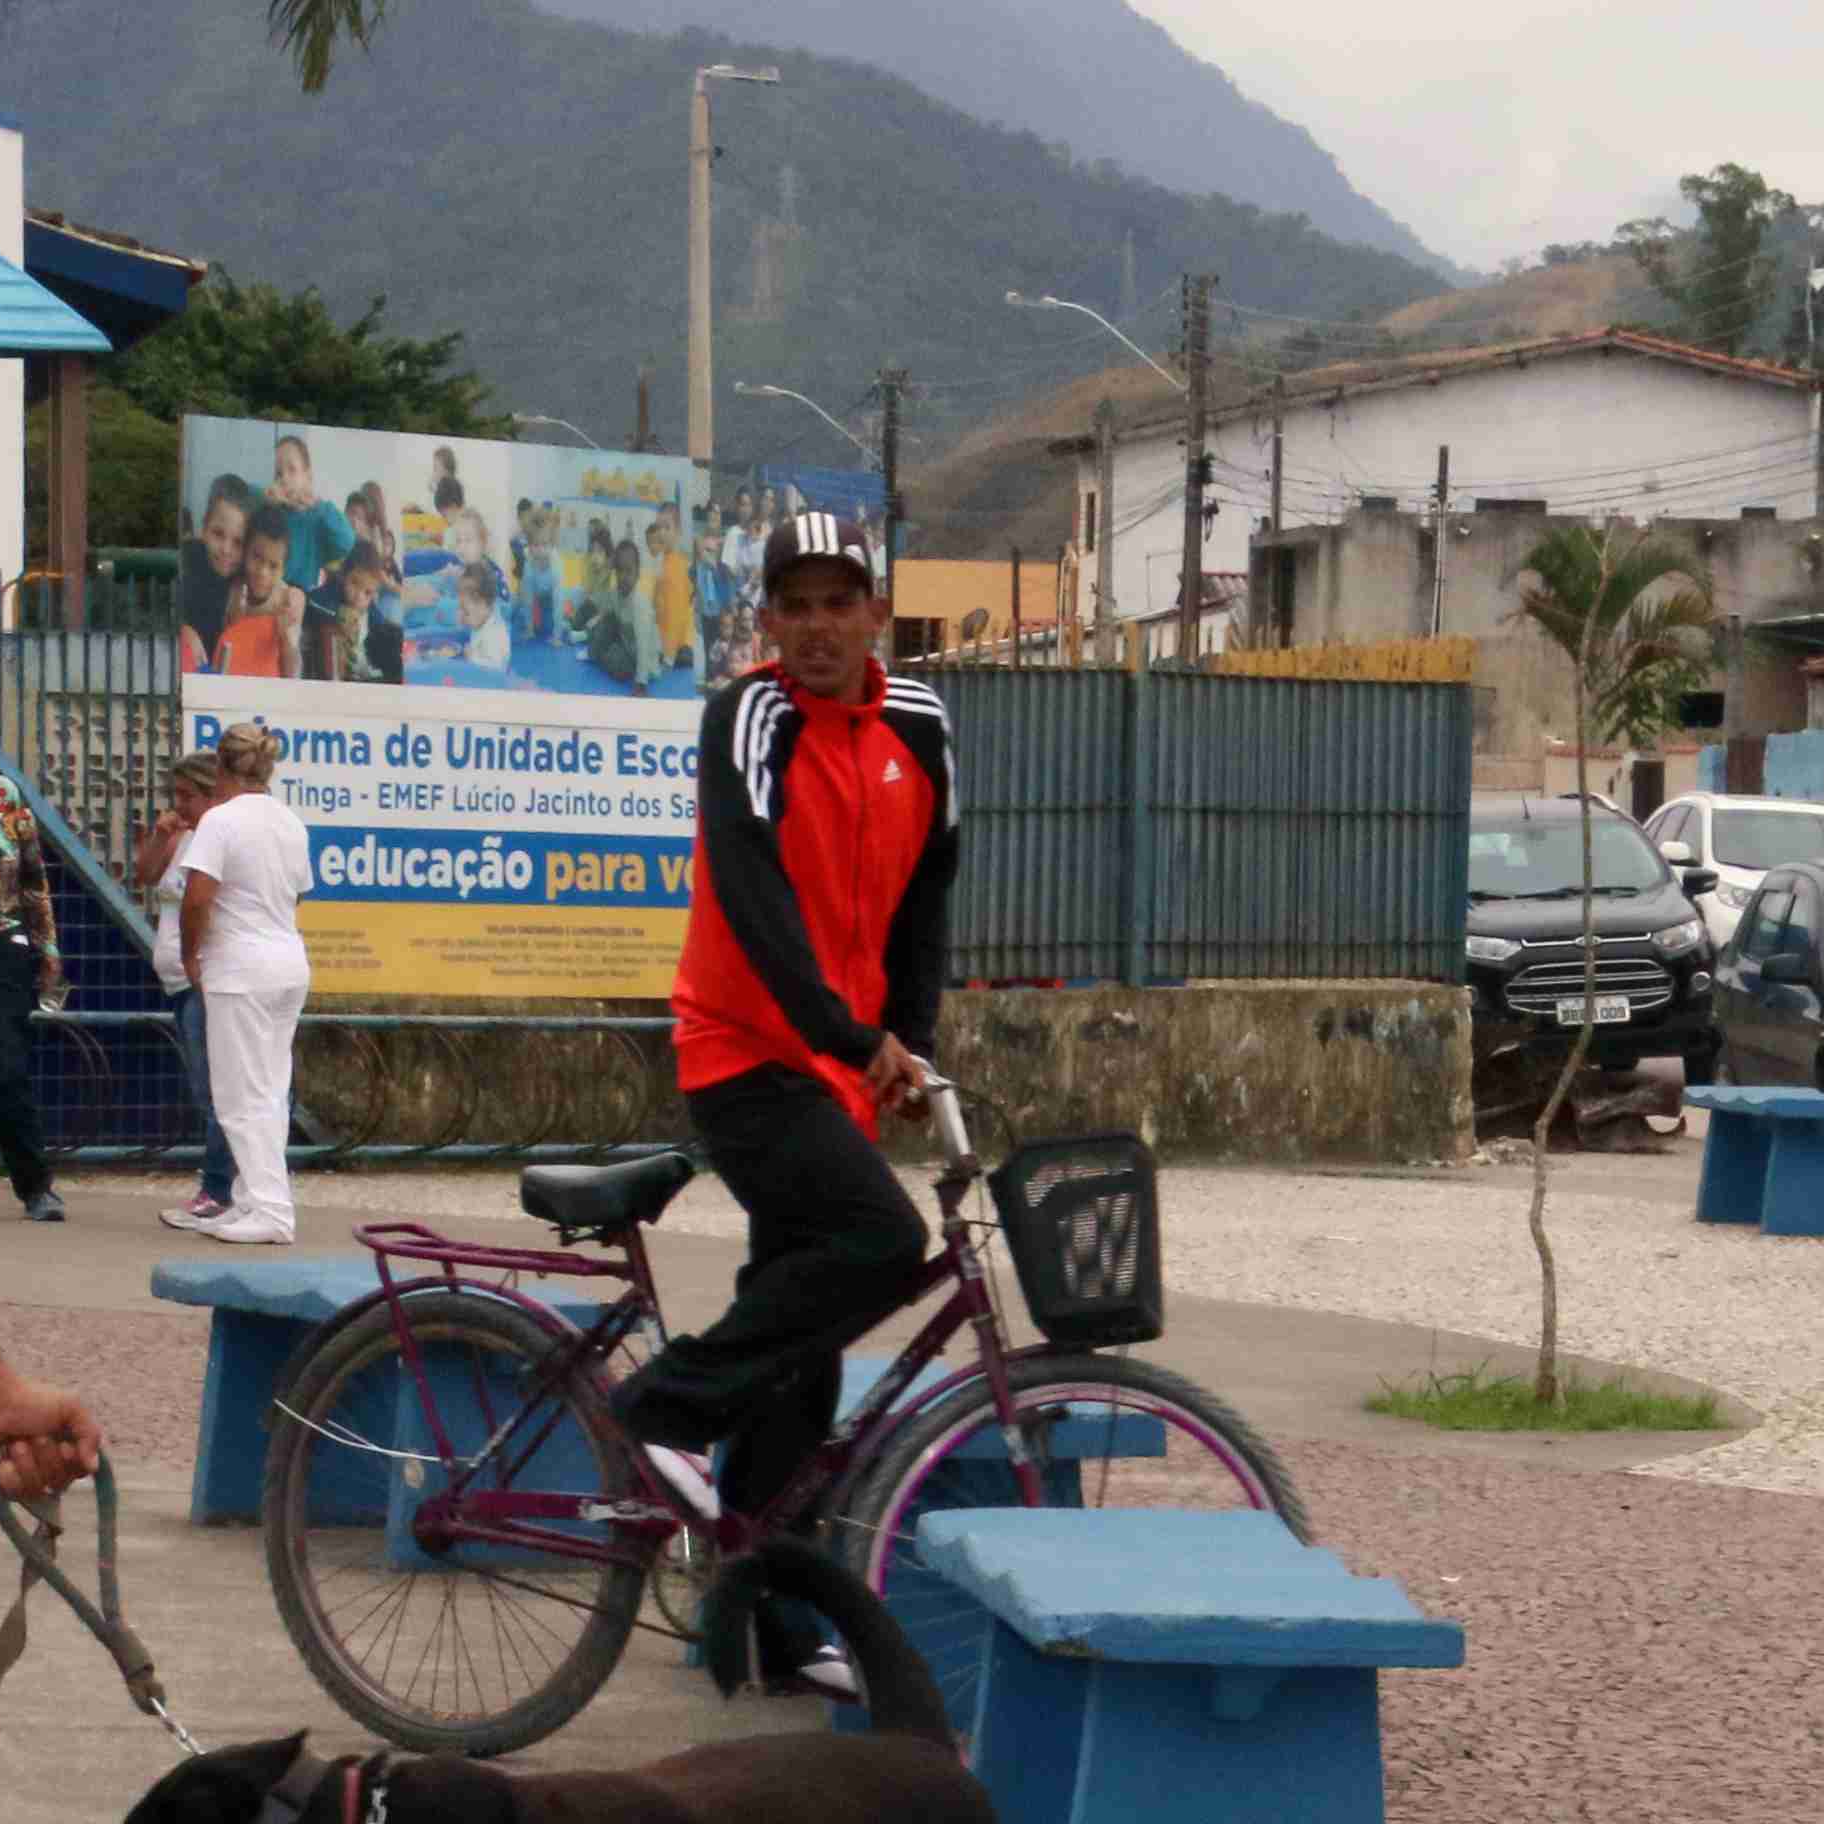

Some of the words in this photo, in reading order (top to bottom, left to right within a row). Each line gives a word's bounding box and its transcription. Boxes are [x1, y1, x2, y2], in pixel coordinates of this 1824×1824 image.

[384, 723, 432, 768] de
[446, 727, 604, 774] Unidade
[616, 734, 702, 778] Esco
[281, 778, 352, 813] Tinga
[378, 782, 444, 811] EMEF
[452, 784, 516, 812] Lúcio
[524, 787, 612, 816] Jacinto
[620, 790, 662, 818] dos
[319, 832, 533, 899] educação
[545, 851, 646, 902] para
